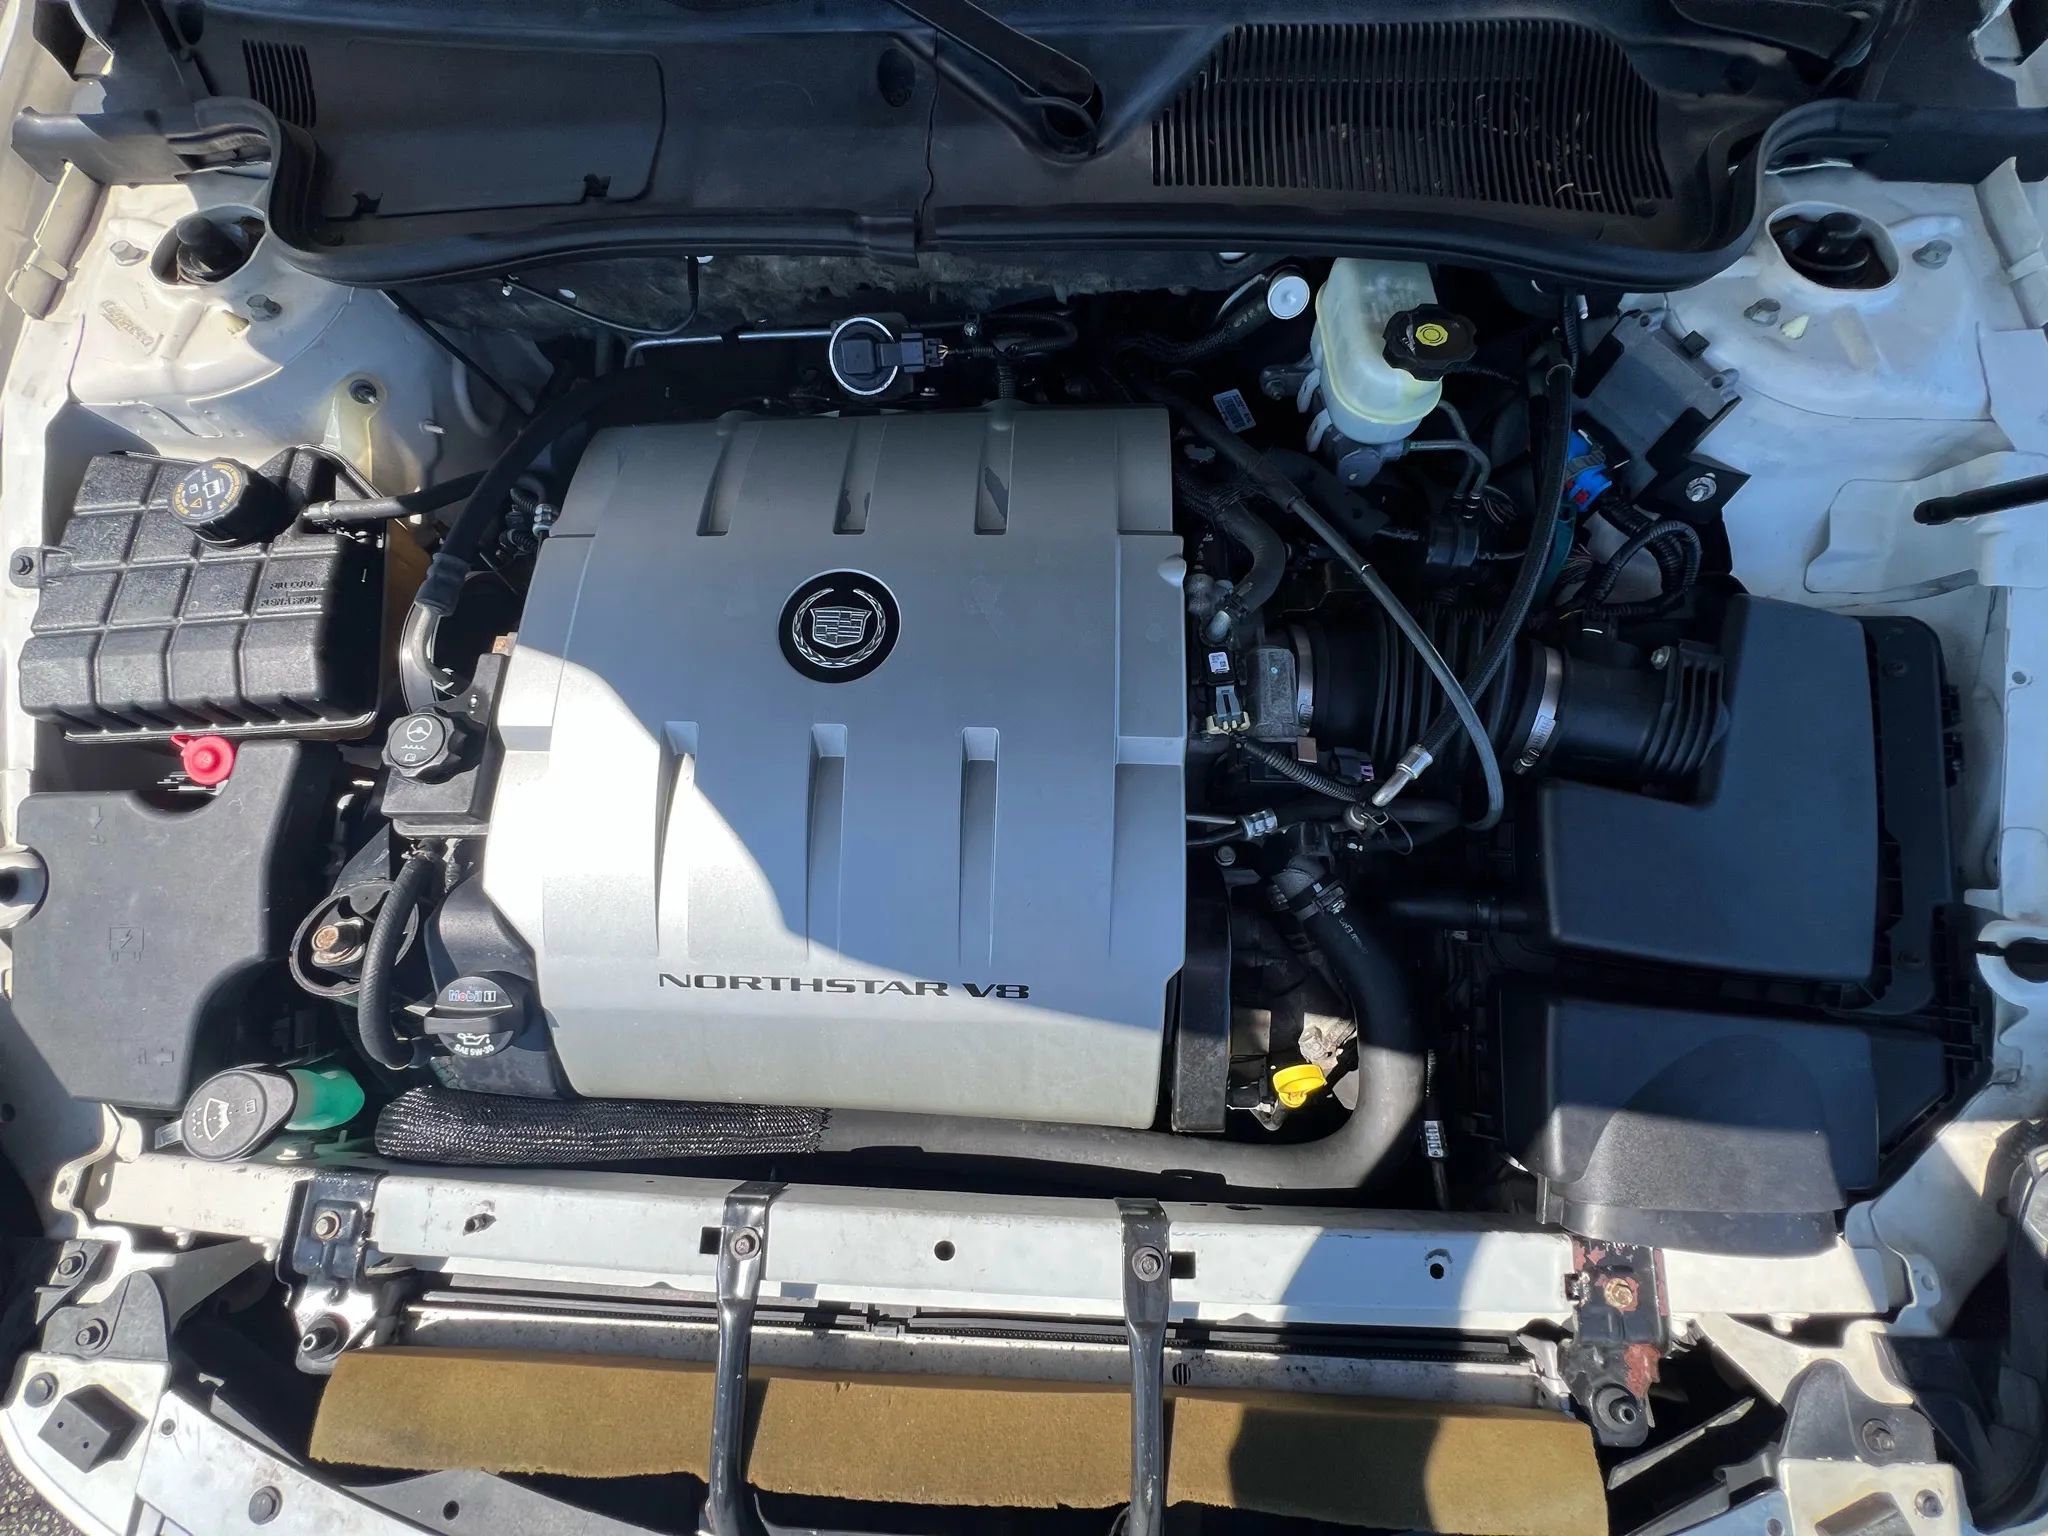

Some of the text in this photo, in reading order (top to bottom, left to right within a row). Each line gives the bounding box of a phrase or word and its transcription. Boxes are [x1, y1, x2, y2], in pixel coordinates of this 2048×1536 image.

[658, 973, 1030, 999] NORTHSTAR V8
[449, 990, 496, 1002] Mobil 1
[454, 1043, 494, 1056] SAE 5W-30
